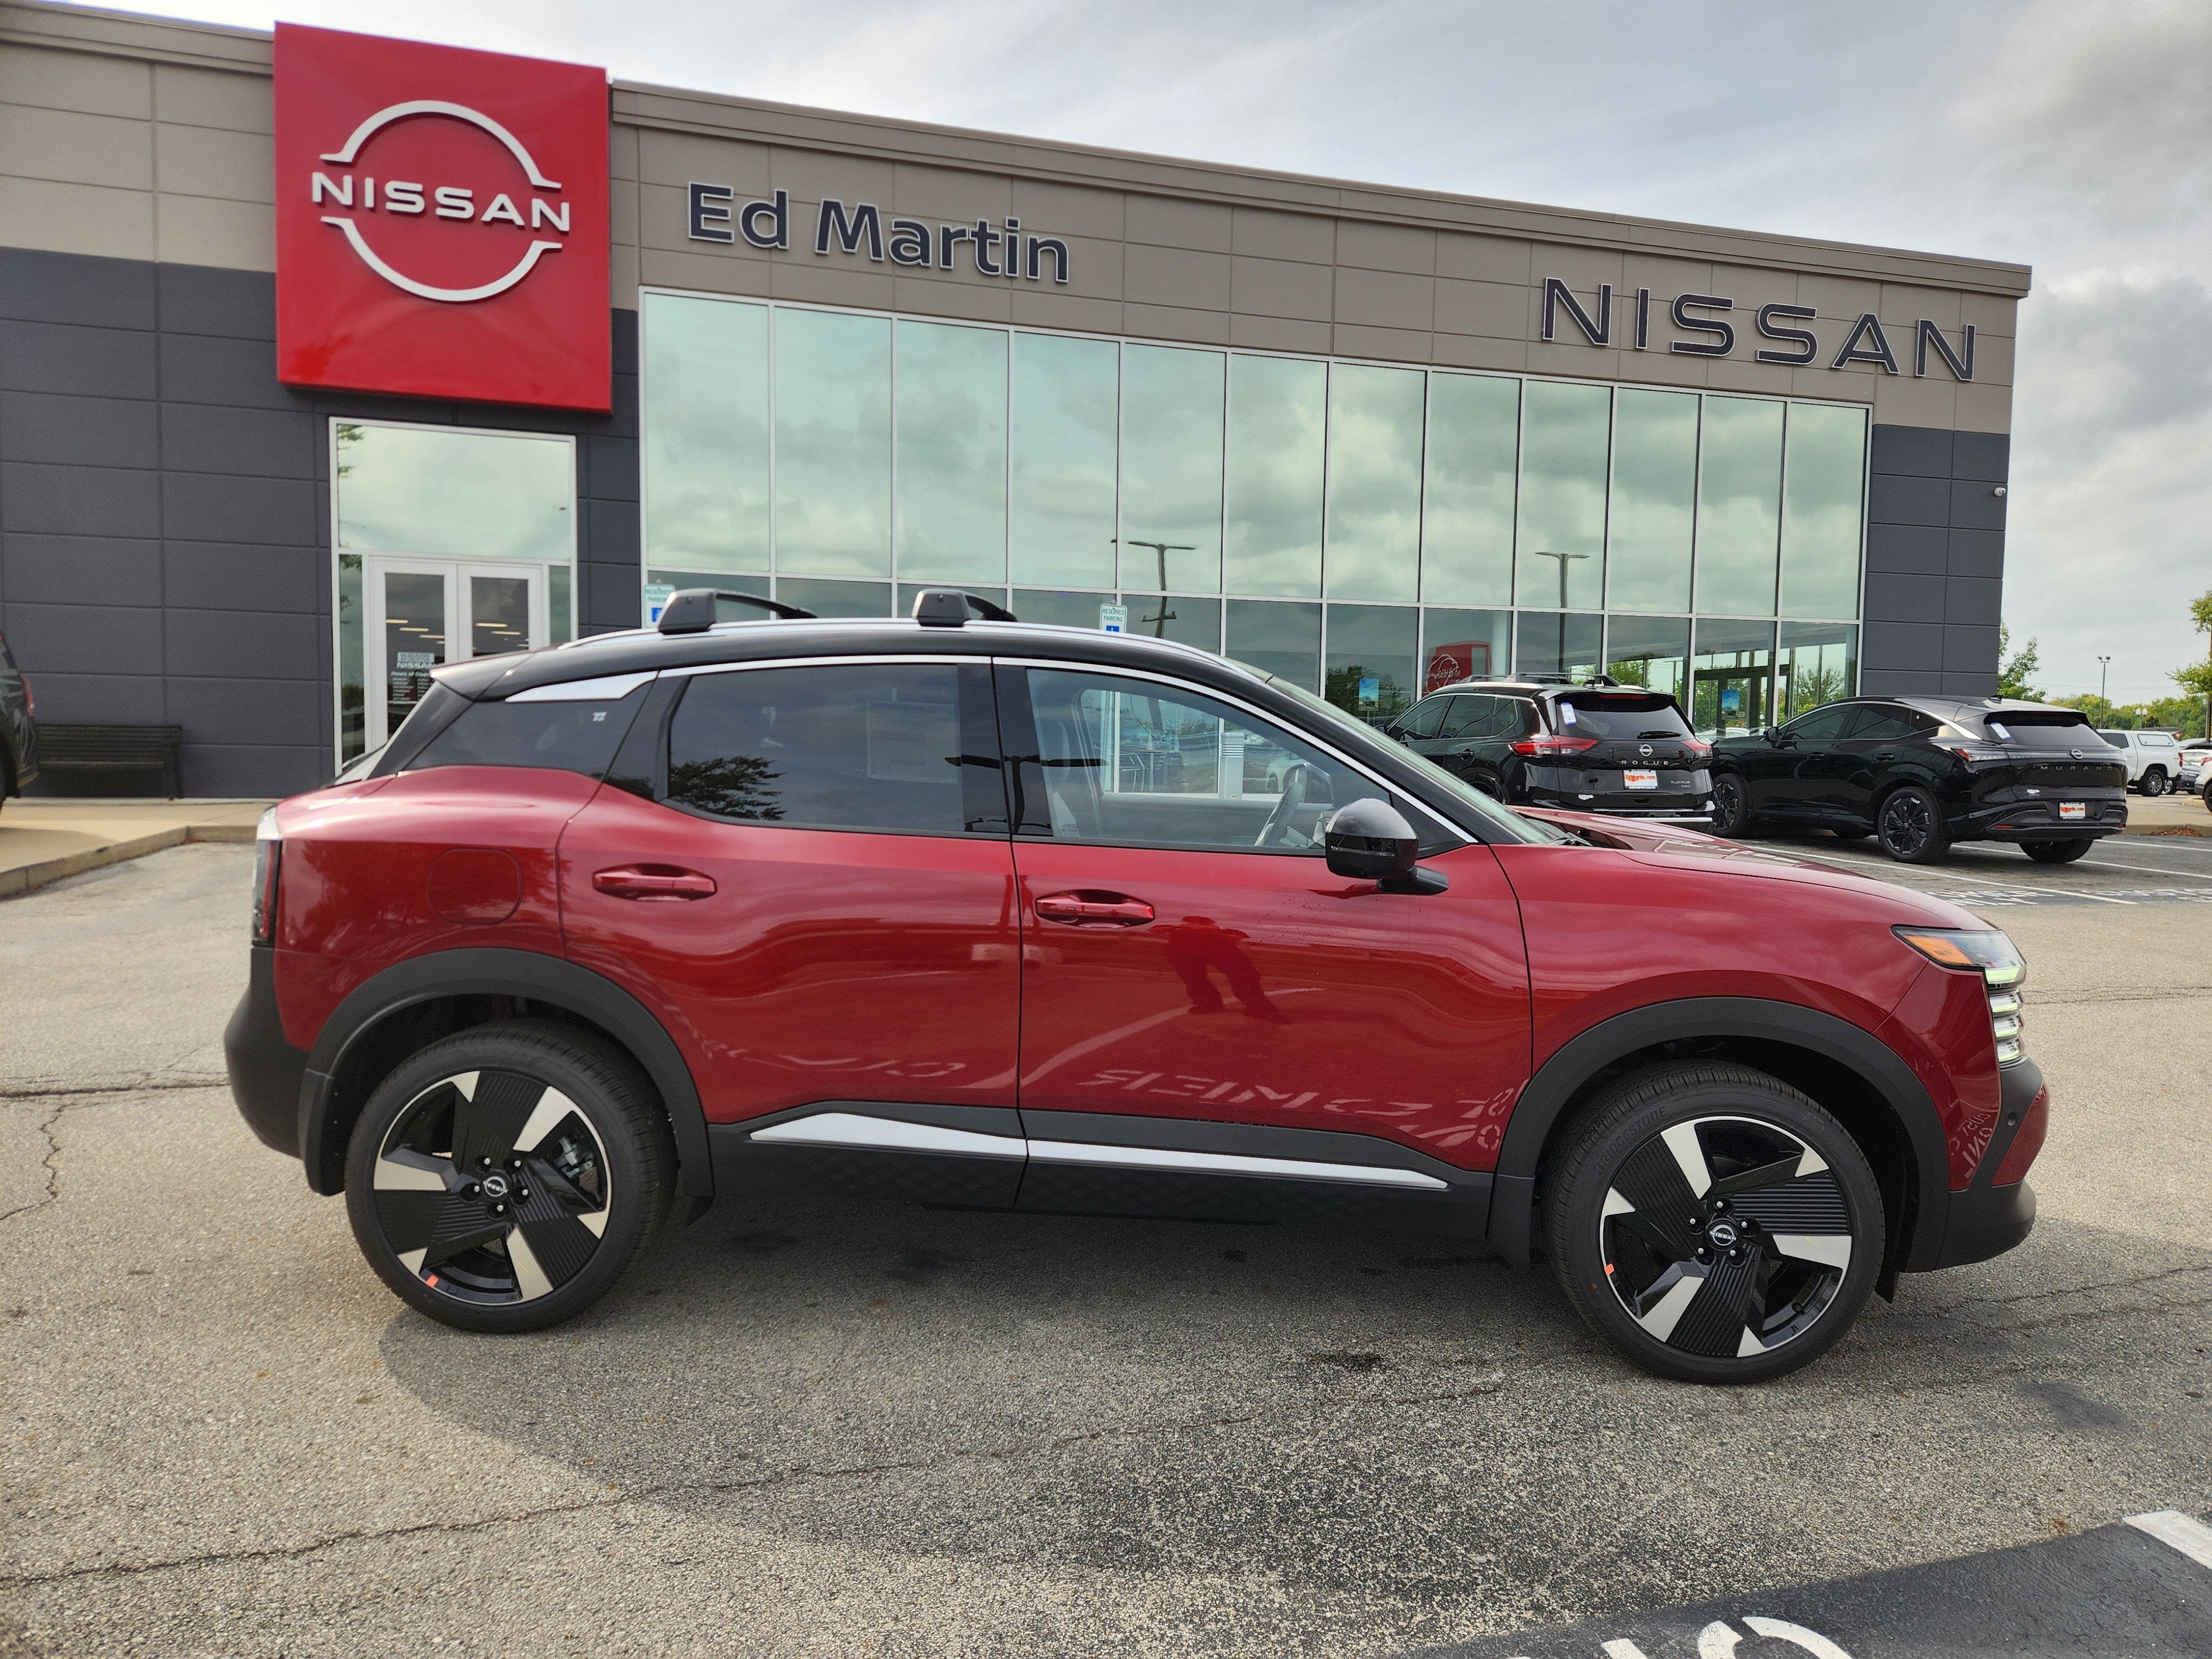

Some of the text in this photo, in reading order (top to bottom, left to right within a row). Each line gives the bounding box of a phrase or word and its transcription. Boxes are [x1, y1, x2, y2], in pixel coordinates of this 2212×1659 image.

[312, 171, 570, 232] NISSAN
[688, 181, 1069, 284] Ed Martin
[1541, 276, 1976, 382] NISSAN
[1593, 1107, 1666, 1176] BRIDGESTONE
[1710, 1230, 1736, 1241] NISSAN
